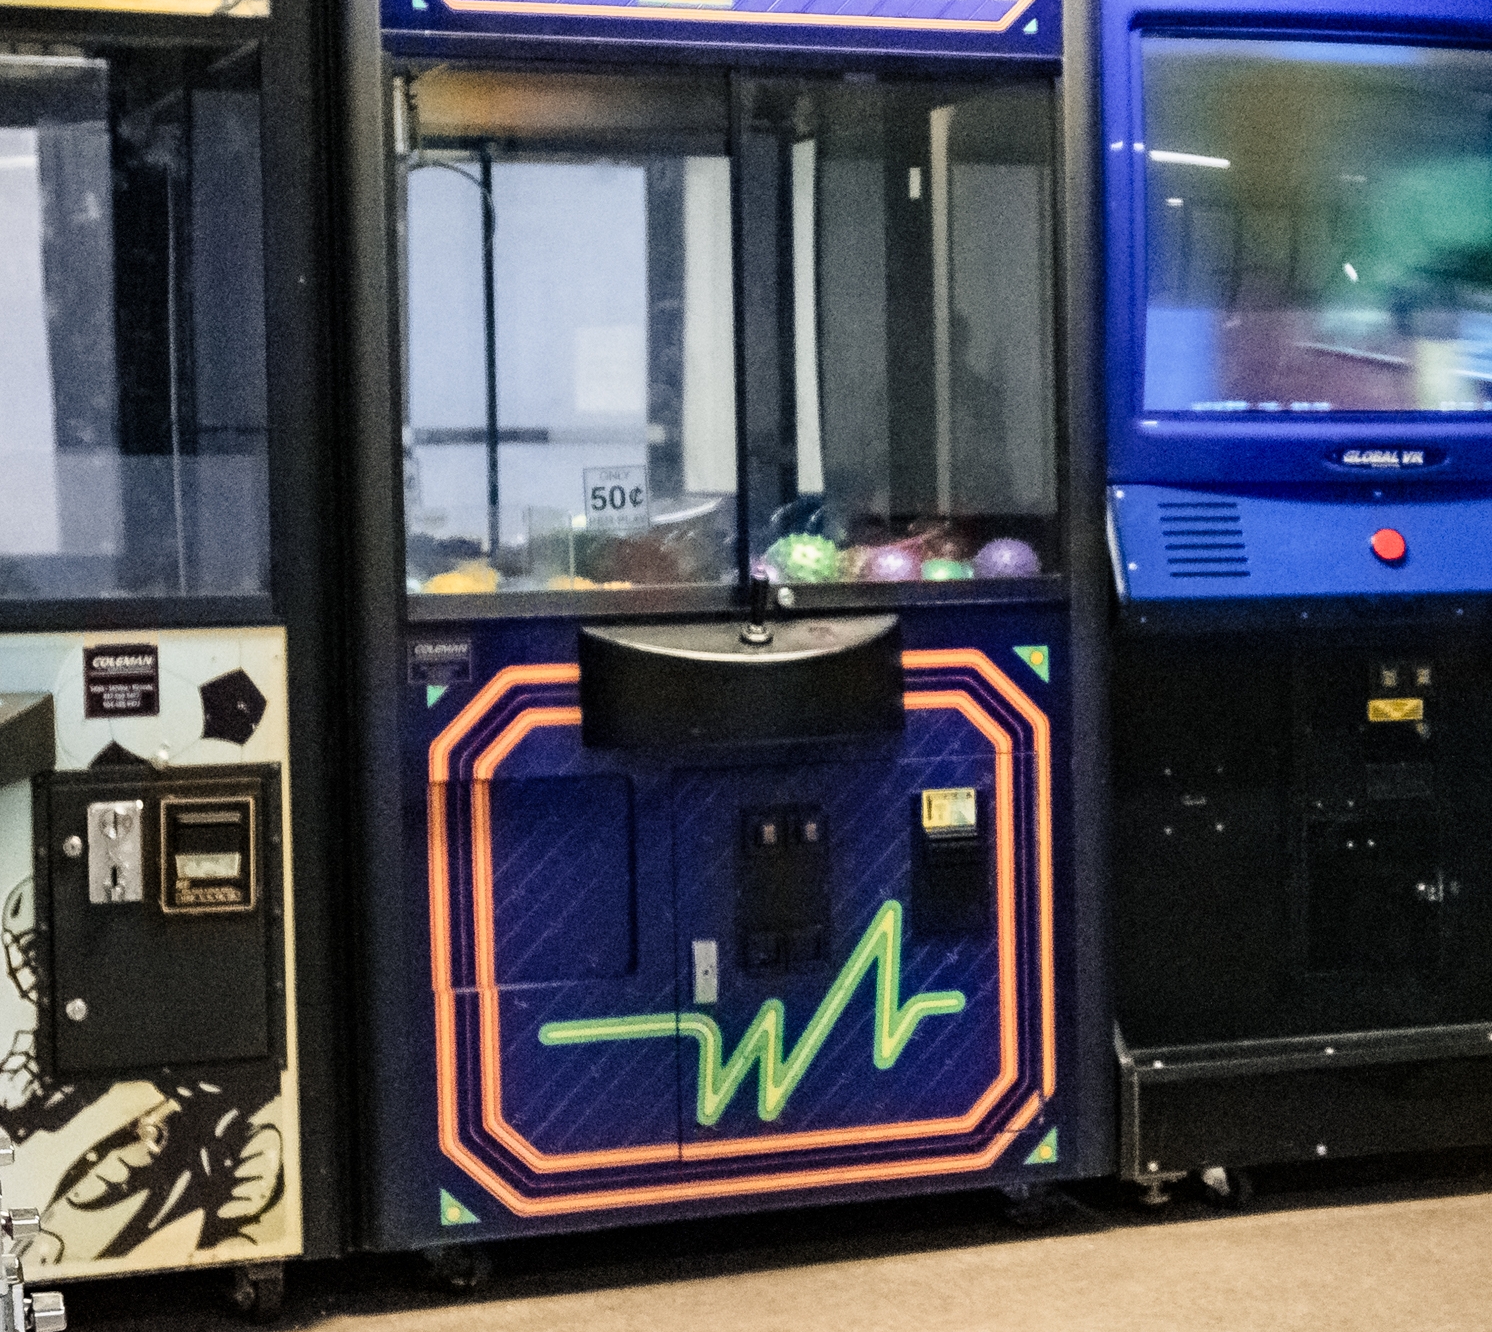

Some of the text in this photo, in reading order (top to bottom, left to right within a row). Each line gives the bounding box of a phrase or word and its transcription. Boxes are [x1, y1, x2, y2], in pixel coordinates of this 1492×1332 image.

[1343, 450, 1399, 465] GLOBAL
[590, 484, 644, 512] 50¢
[91, 654, 153, 669] COLEMAN
